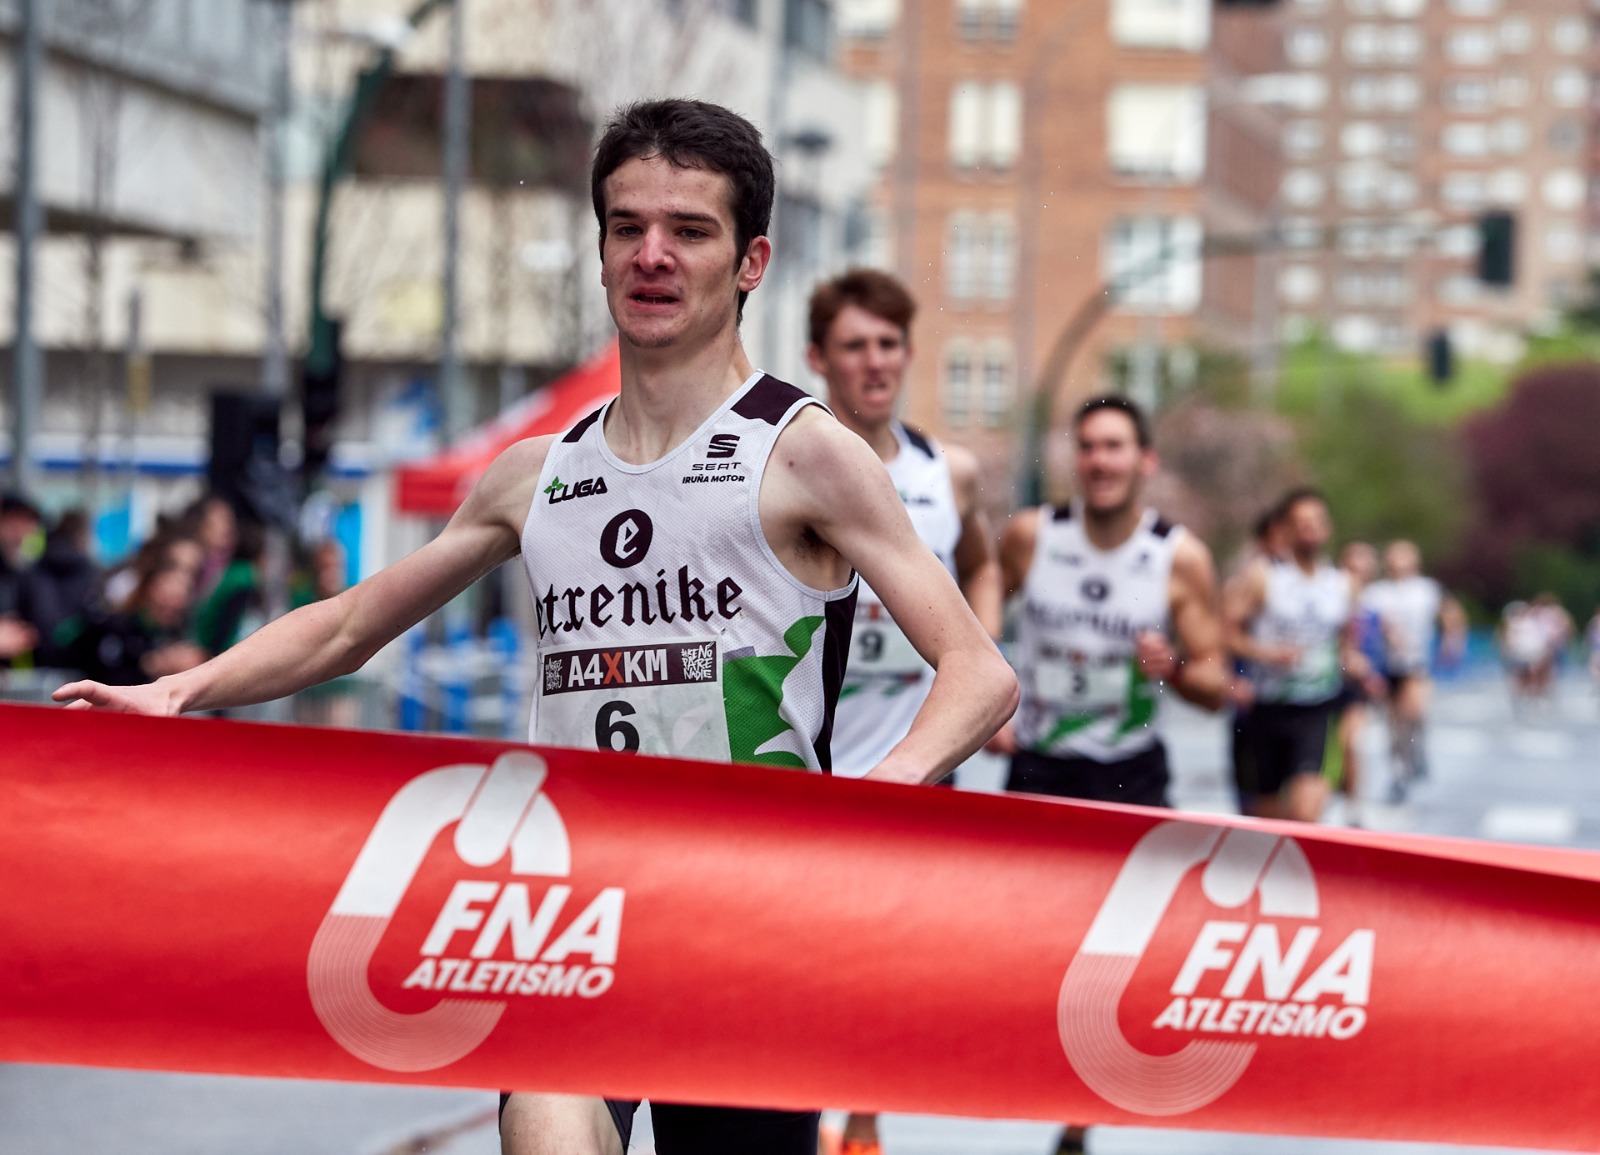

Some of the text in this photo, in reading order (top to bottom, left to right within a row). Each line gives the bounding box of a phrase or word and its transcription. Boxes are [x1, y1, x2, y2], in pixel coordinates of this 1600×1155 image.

[682, 473, 745, 484] IRUÑA MOTOR
[691, 462, 742, 471] SEAT
[549, 476, 608, 504] LUGA
[681, 655, 714, 672] PARE
[859, 629, 884, 662] 9
[567, 648, 669, 688] A4XKM
[683, 667, 713, 681] NADIE
[594, 700, 640, 756] 6
[419, 880, 625, 965] FNA
[401, 957, 615, 999] ATLETISMO
[1170, 920, 1376, 1006] FNA
[1151, 996, 1368, 1040] ATLETISMO
